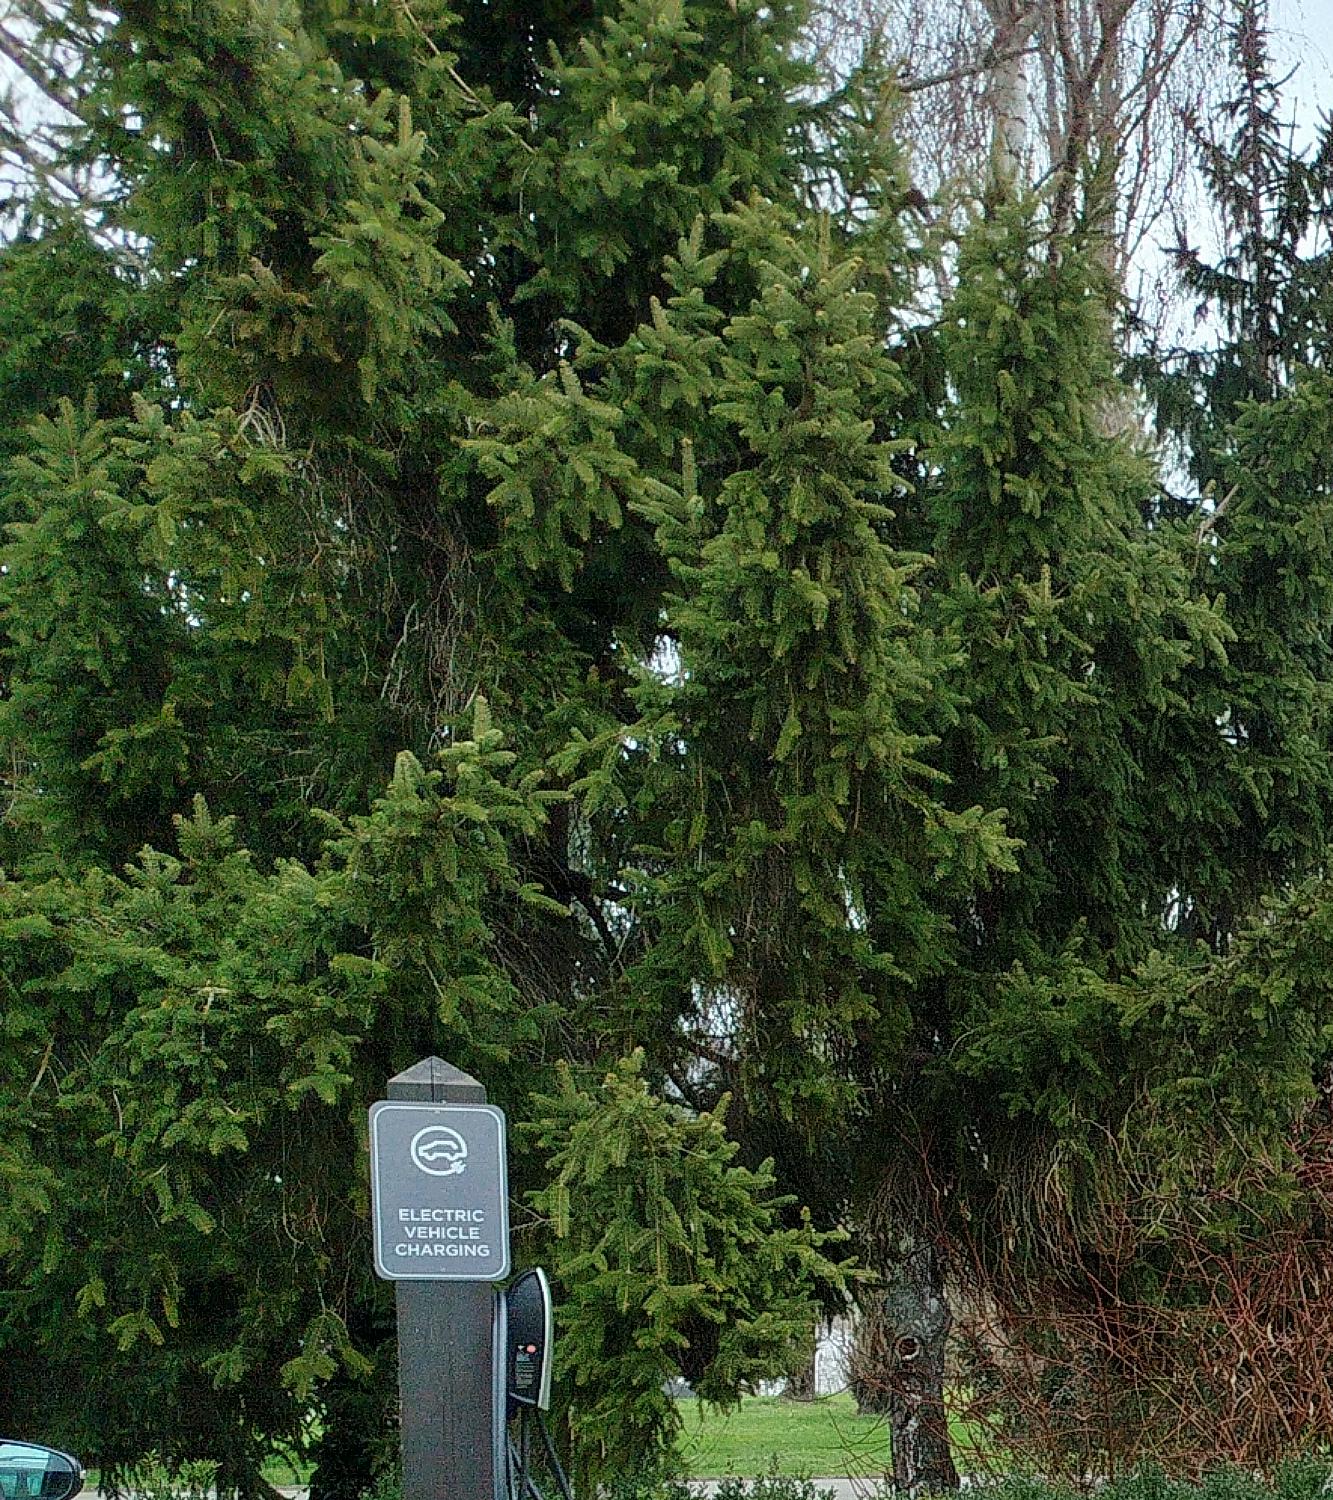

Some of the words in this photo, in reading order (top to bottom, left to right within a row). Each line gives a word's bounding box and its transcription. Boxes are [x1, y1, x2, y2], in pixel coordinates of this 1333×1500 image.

[398, 1208, 485, 1223] ELECTRIC
[404, 1226, 480, 1240] VEHICLE
[395, 1243, 490, 1257] CHARGING
